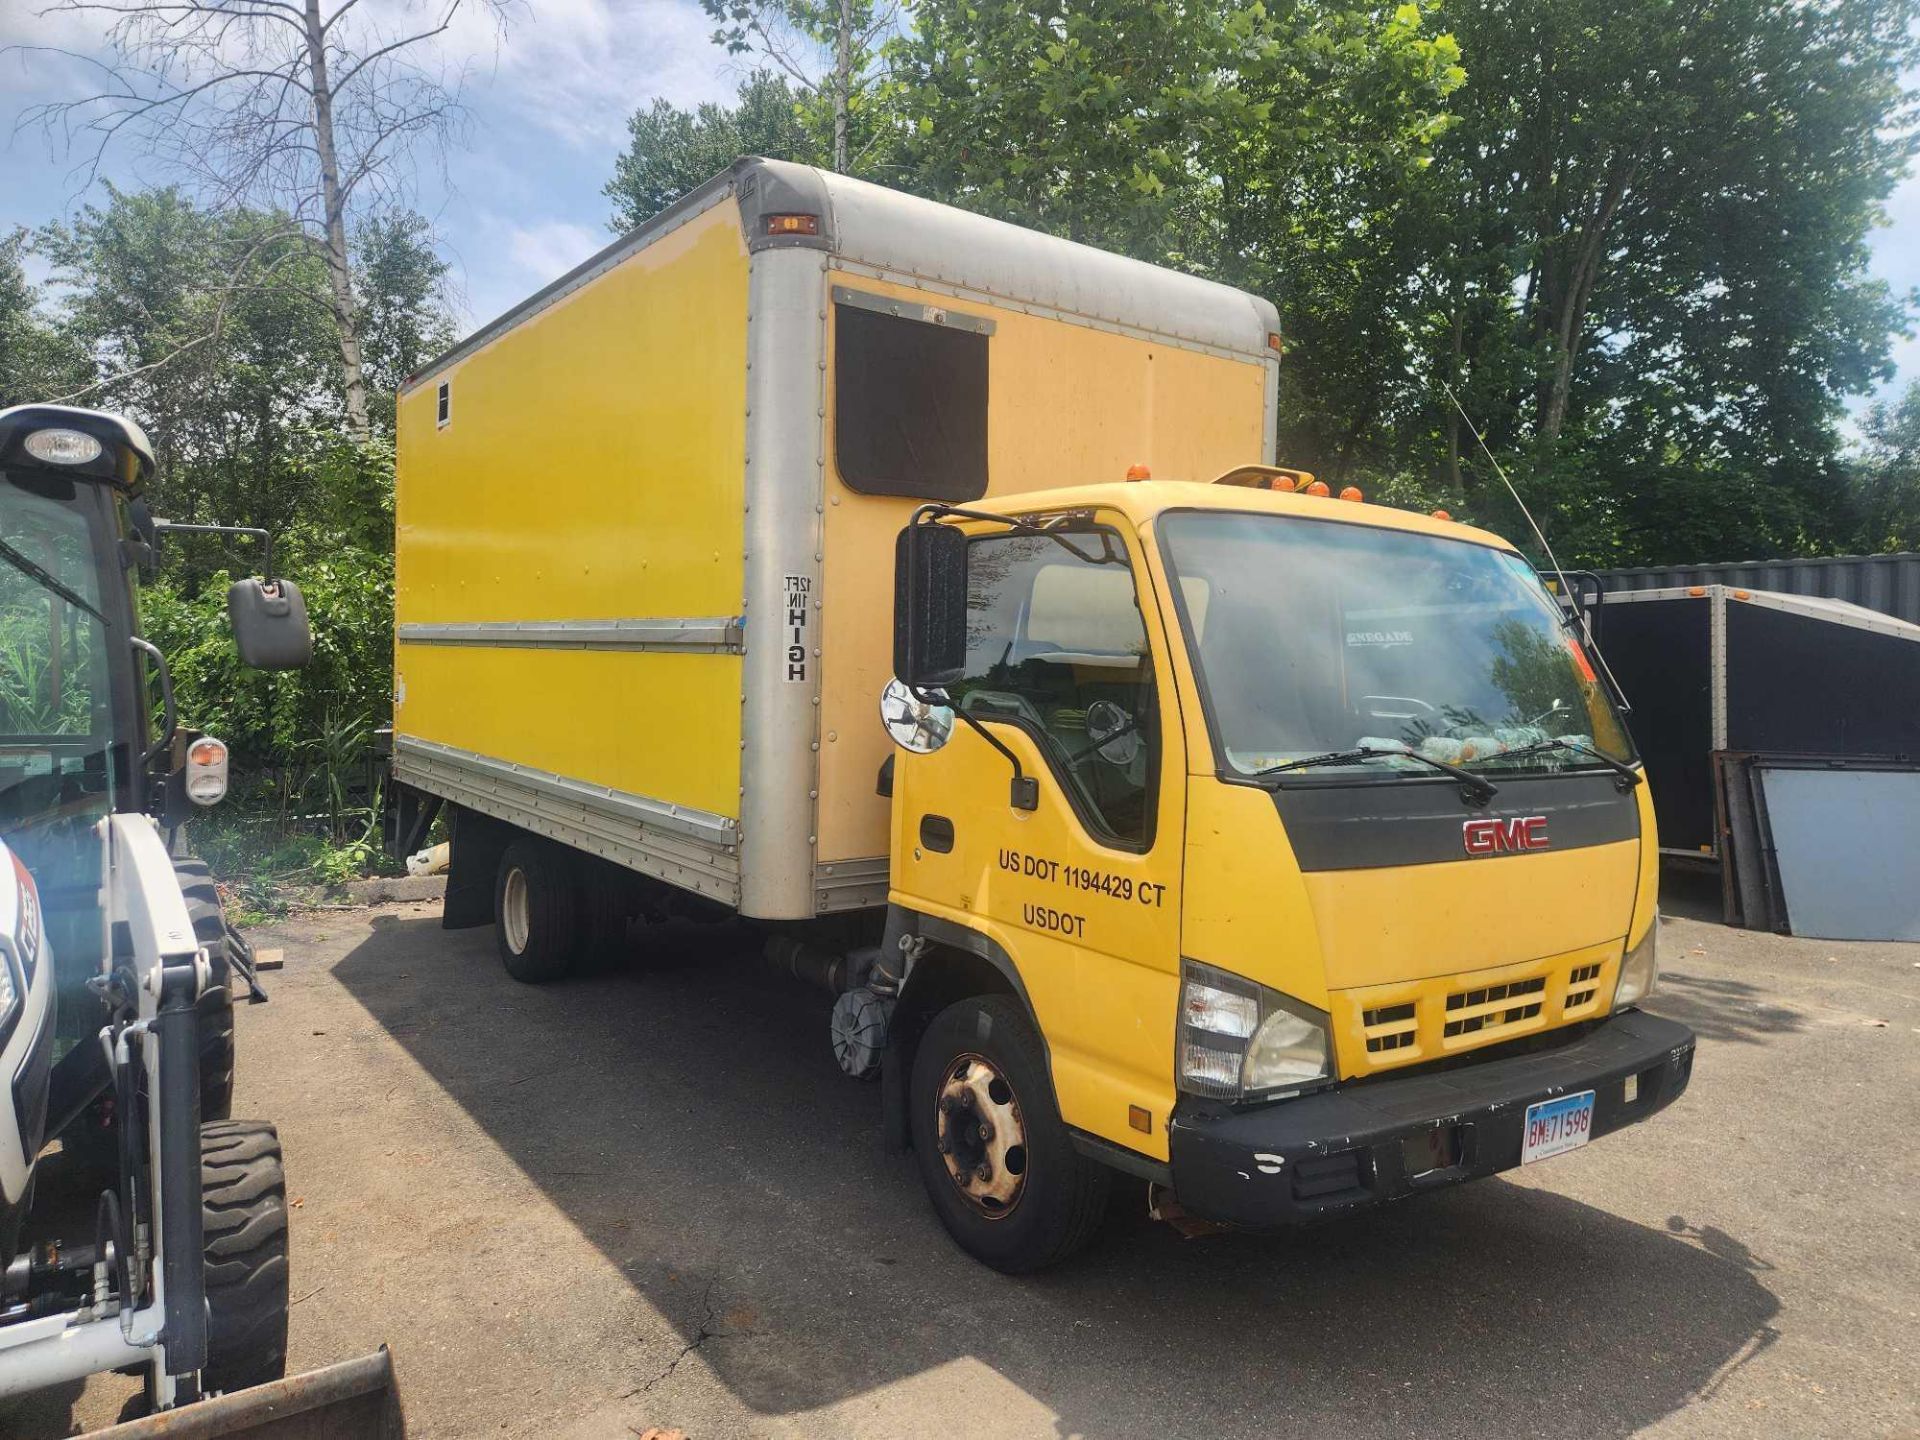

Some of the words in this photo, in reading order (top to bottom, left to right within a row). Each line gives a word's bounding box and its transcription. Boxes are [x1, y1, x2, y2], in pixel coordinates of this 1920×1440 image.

[1463, 816, 1551, 854] GMC
[999, 849, 1020, 872] US
[1024, 855, 1059, 882] DOT
[1064, 866, 1132, 900] 1194429
[1138, 882, 1166, 907] CT
[1024, 903, 1085, 938] USDOT
